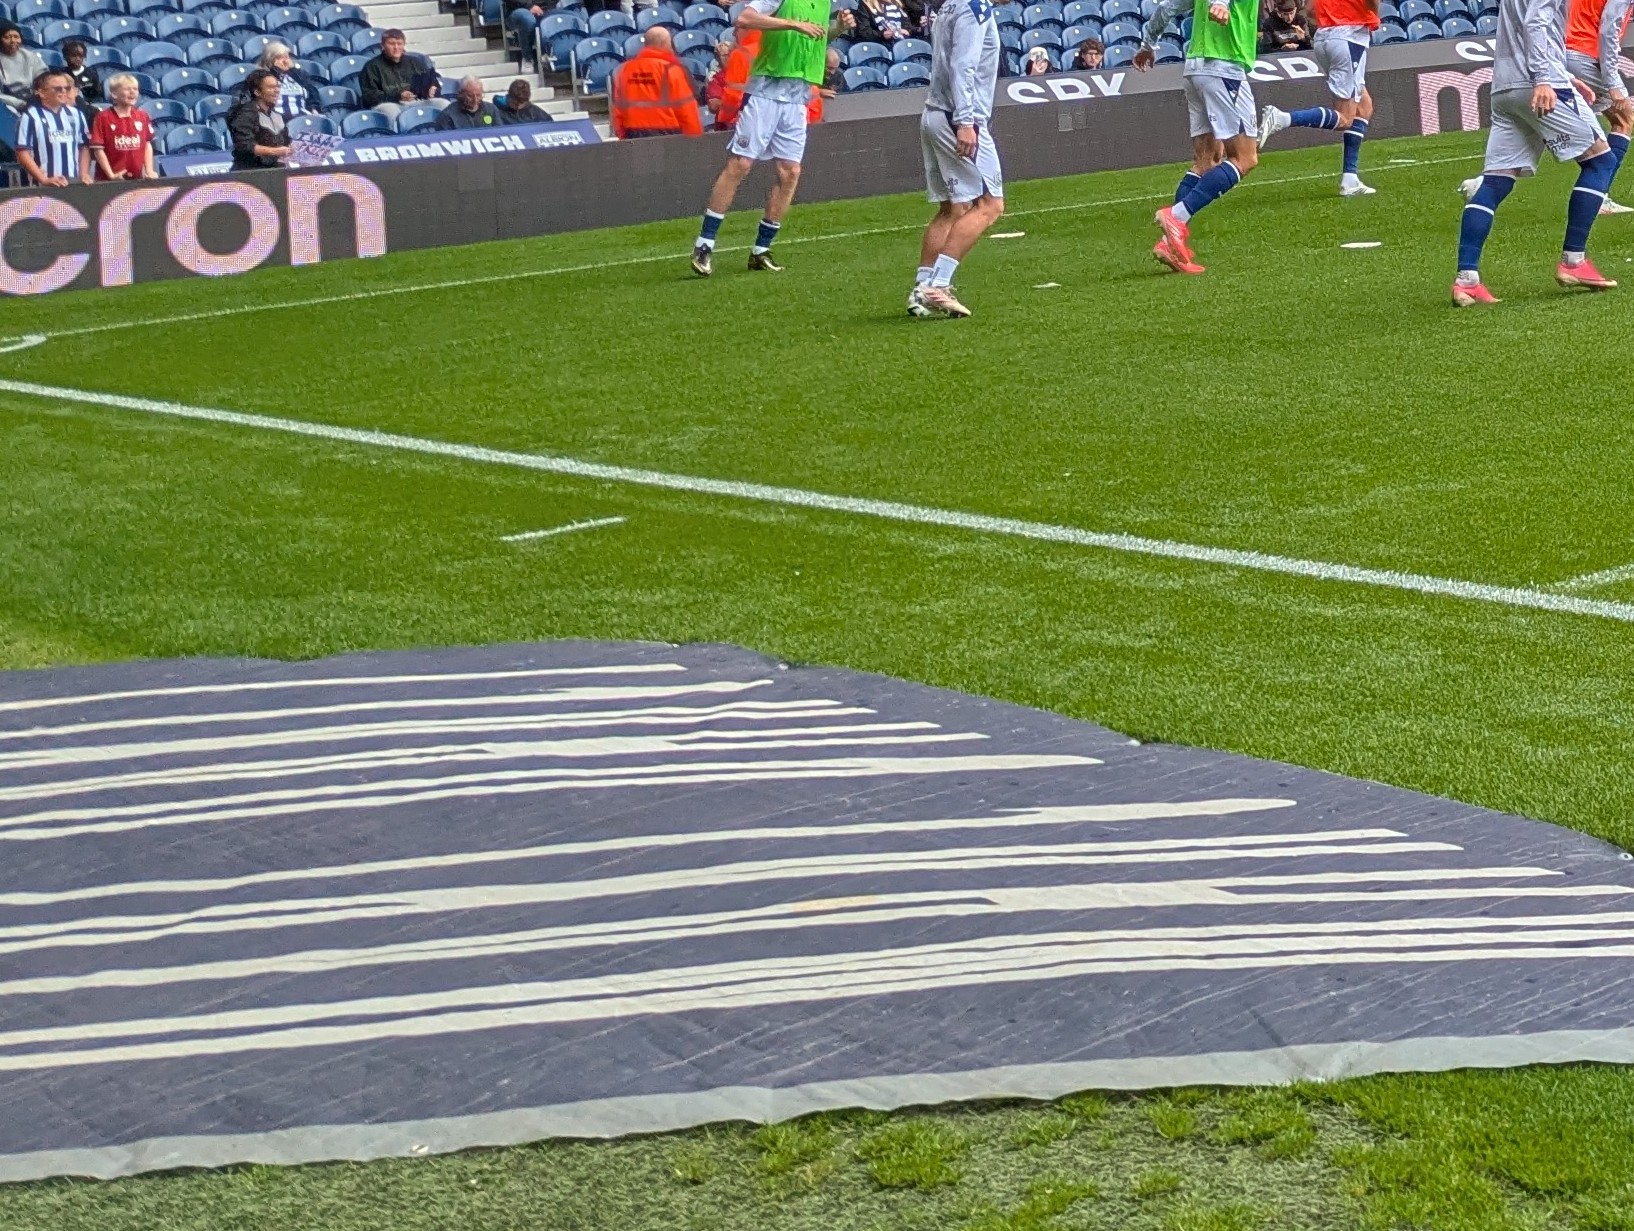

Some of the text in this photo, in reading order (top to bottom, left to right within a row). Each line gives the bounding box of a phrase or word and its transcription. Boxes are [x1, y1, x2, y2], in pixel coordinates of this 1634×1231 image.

[114, 134, 141, 148] ideal
[355, 134, 525, 163] BROMWICH
[0, 173, 388, 295] cron
